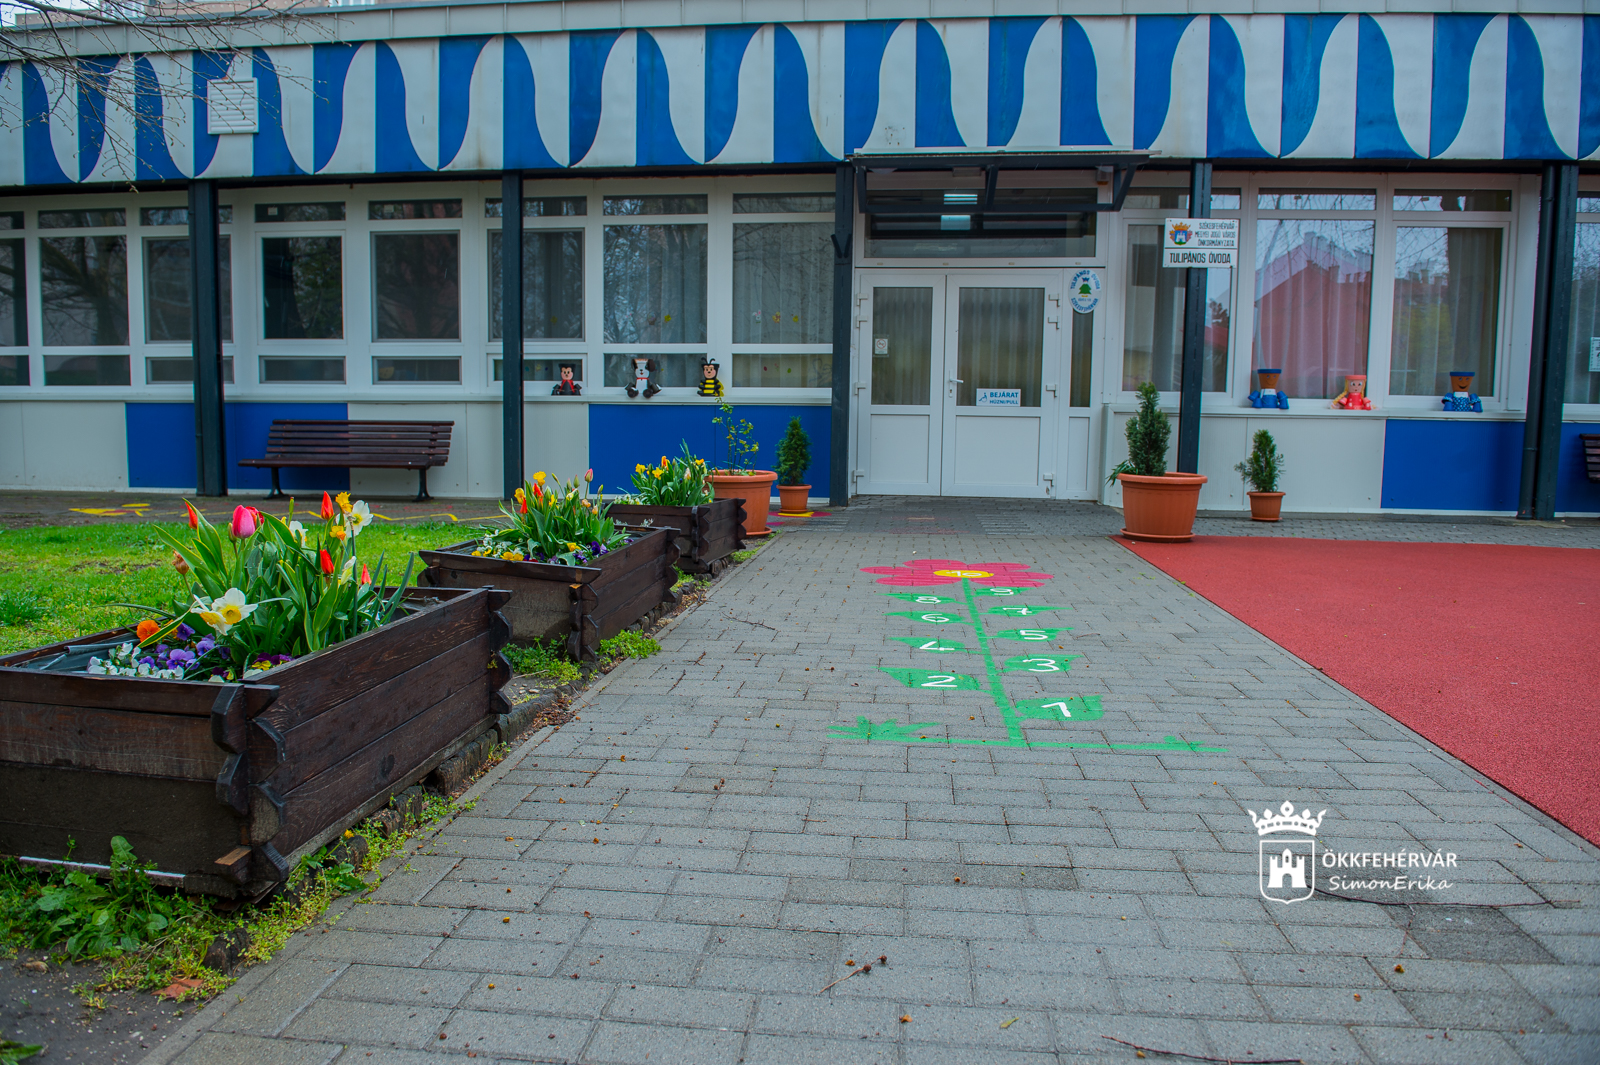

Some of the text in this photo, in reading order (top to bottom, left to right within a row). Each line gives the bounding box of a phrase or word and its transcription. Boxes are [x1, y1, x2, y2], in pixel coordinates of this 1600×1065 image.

[1170, 251, 1231, 264] TULIPÁNOS ÓVODA
[990, 588, 1014, 596] 9
[915, 596, 941, 604] 8
[1002, 607, 1032, 616] 7
[922, 614, 950, 622] 6
[1020, 630, 1048, 640] 5
[919, 641, 955, 651] 4
[1022, 658, 1060, 672] 3
[920, 675, 958, 688] 2
[1041, 702, 1072, 718] 1
